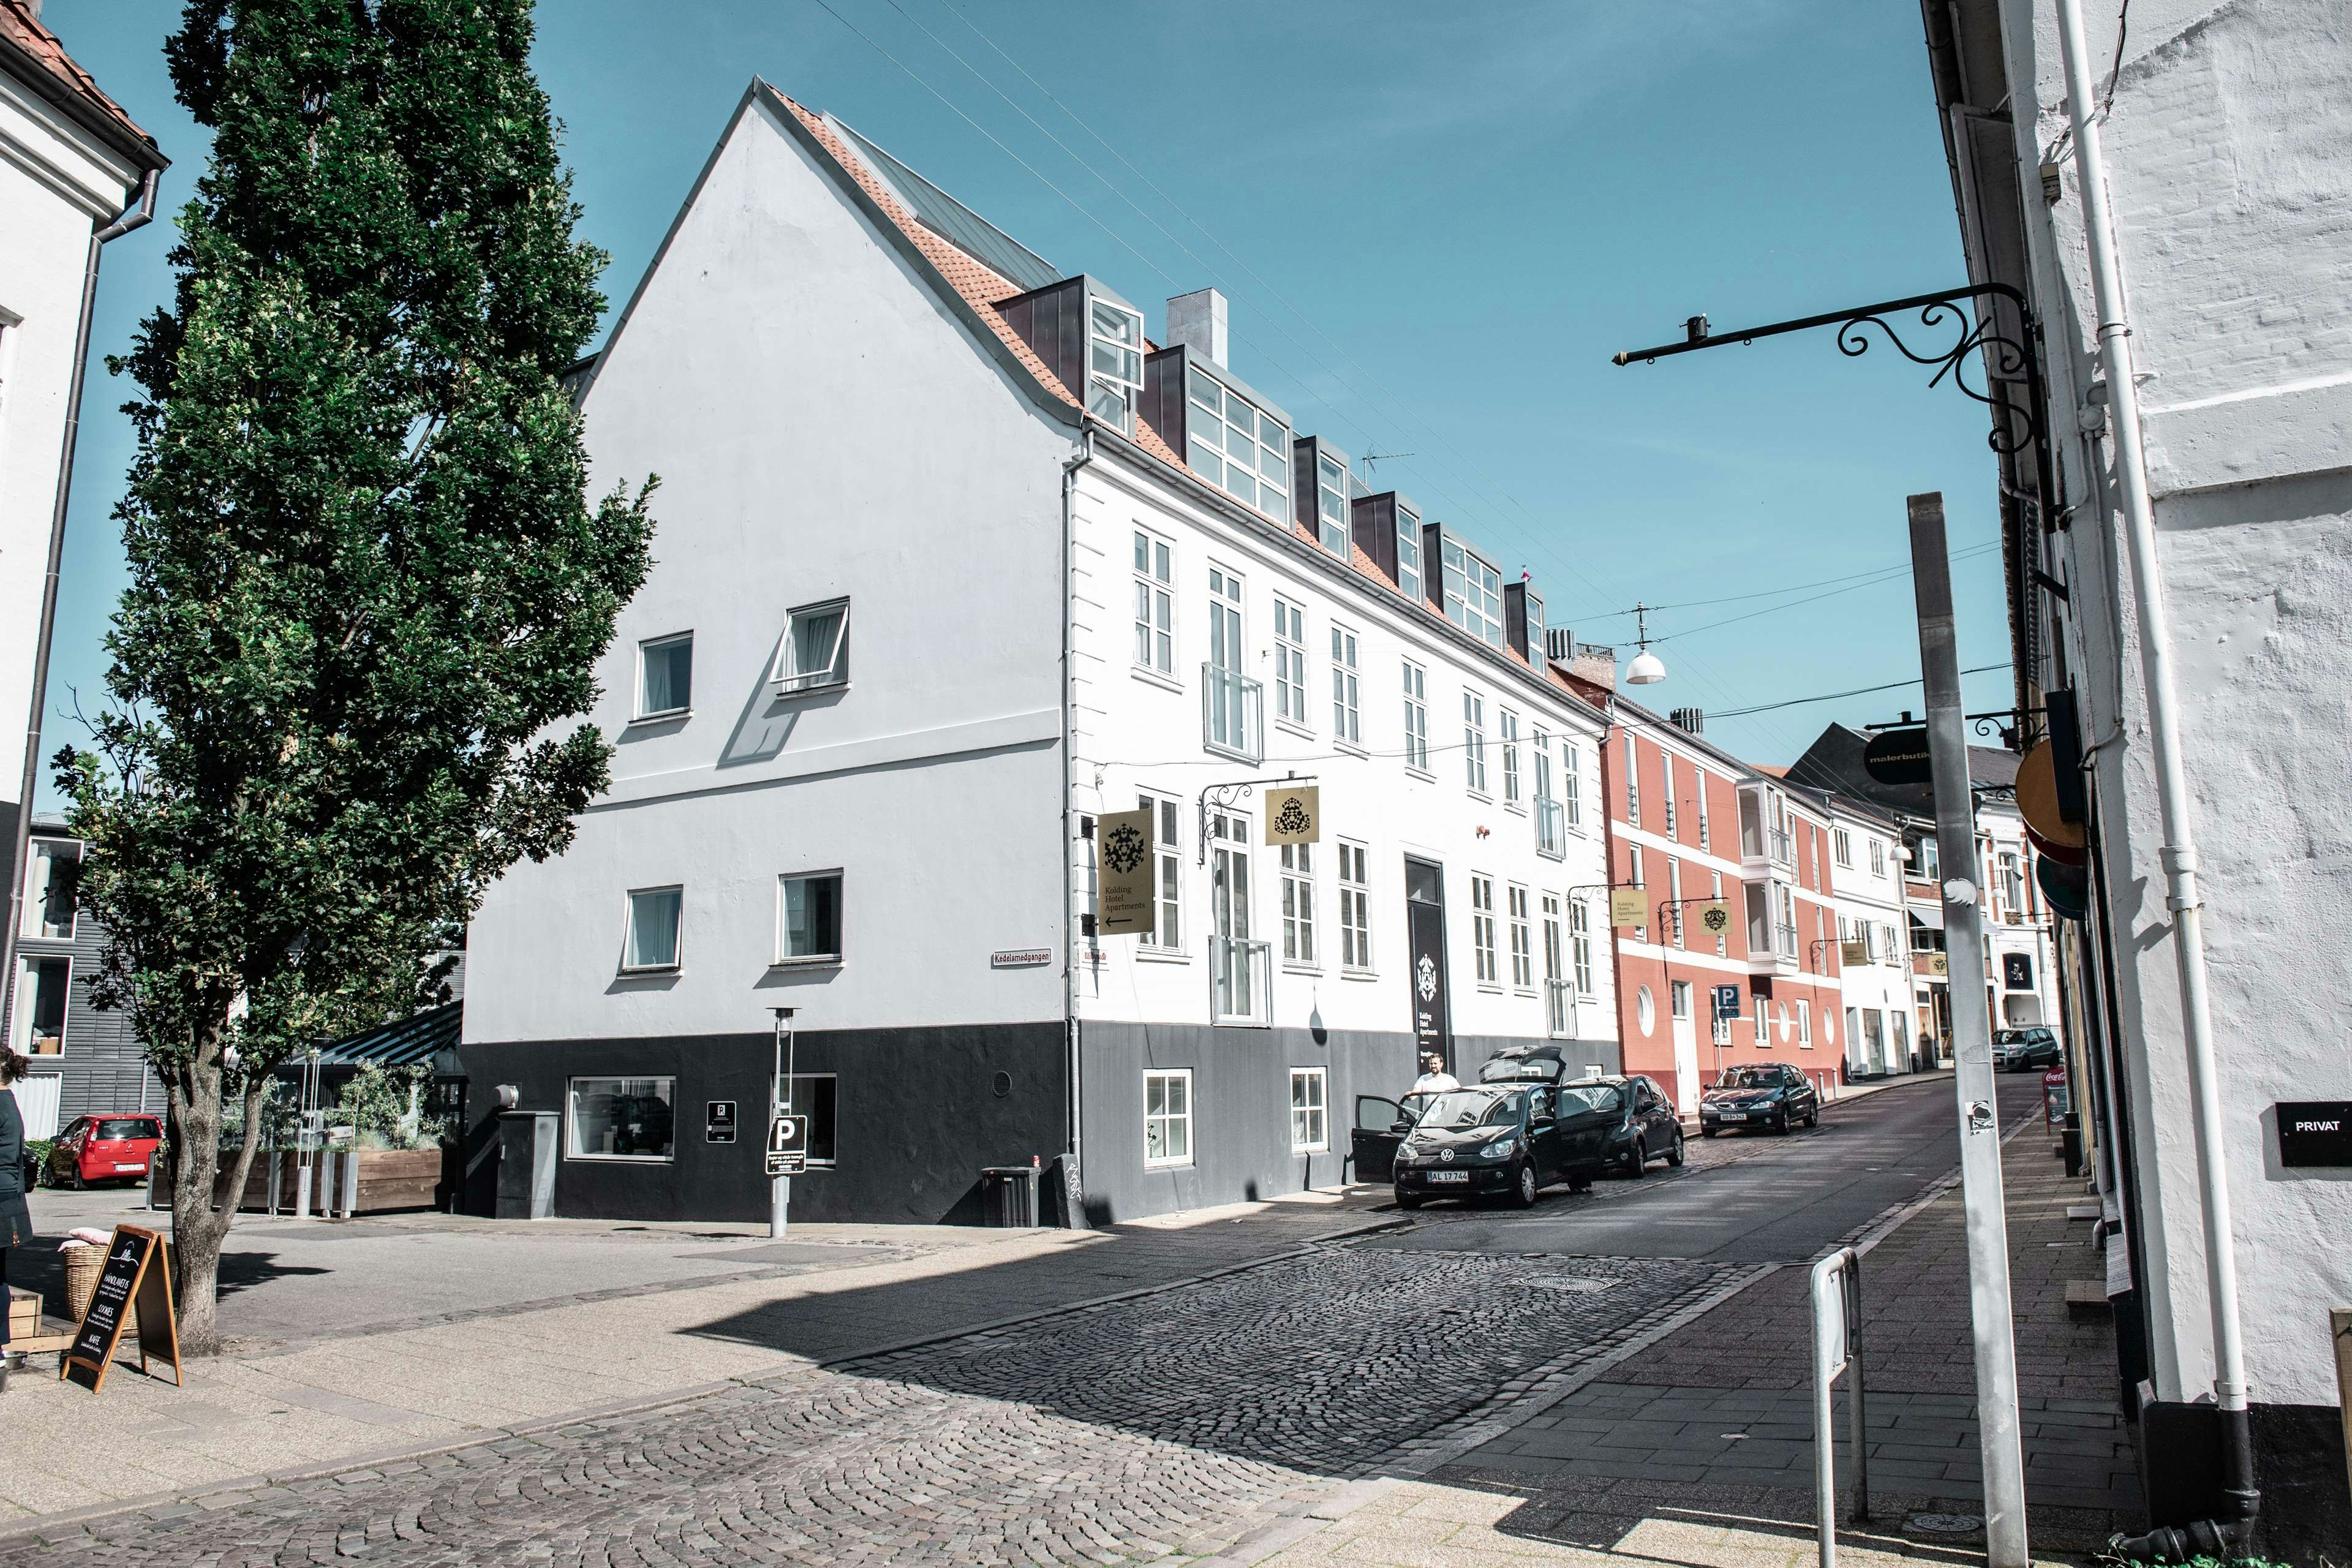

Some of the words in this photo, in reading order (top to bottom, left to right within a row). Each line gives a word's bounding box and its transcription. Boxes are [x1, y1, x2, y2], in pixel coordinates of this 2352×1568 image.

[1105, 886, 1132, 894] Kolding
[1105, 894, 1123, 903] Hotel
[1105, 902, 1145, 913] Apartments
[995, 952, 1050, 963] Kedelsmedgangen
[1722, 989, 1735, 1005] P
[2295, 1121, 2340, 1131] PRIVAT
[776, 1120, 795, 1150] P
[98, 1304, 114, 1317] COOKIES
[88, 1334, 101, 1346] KAFFE
